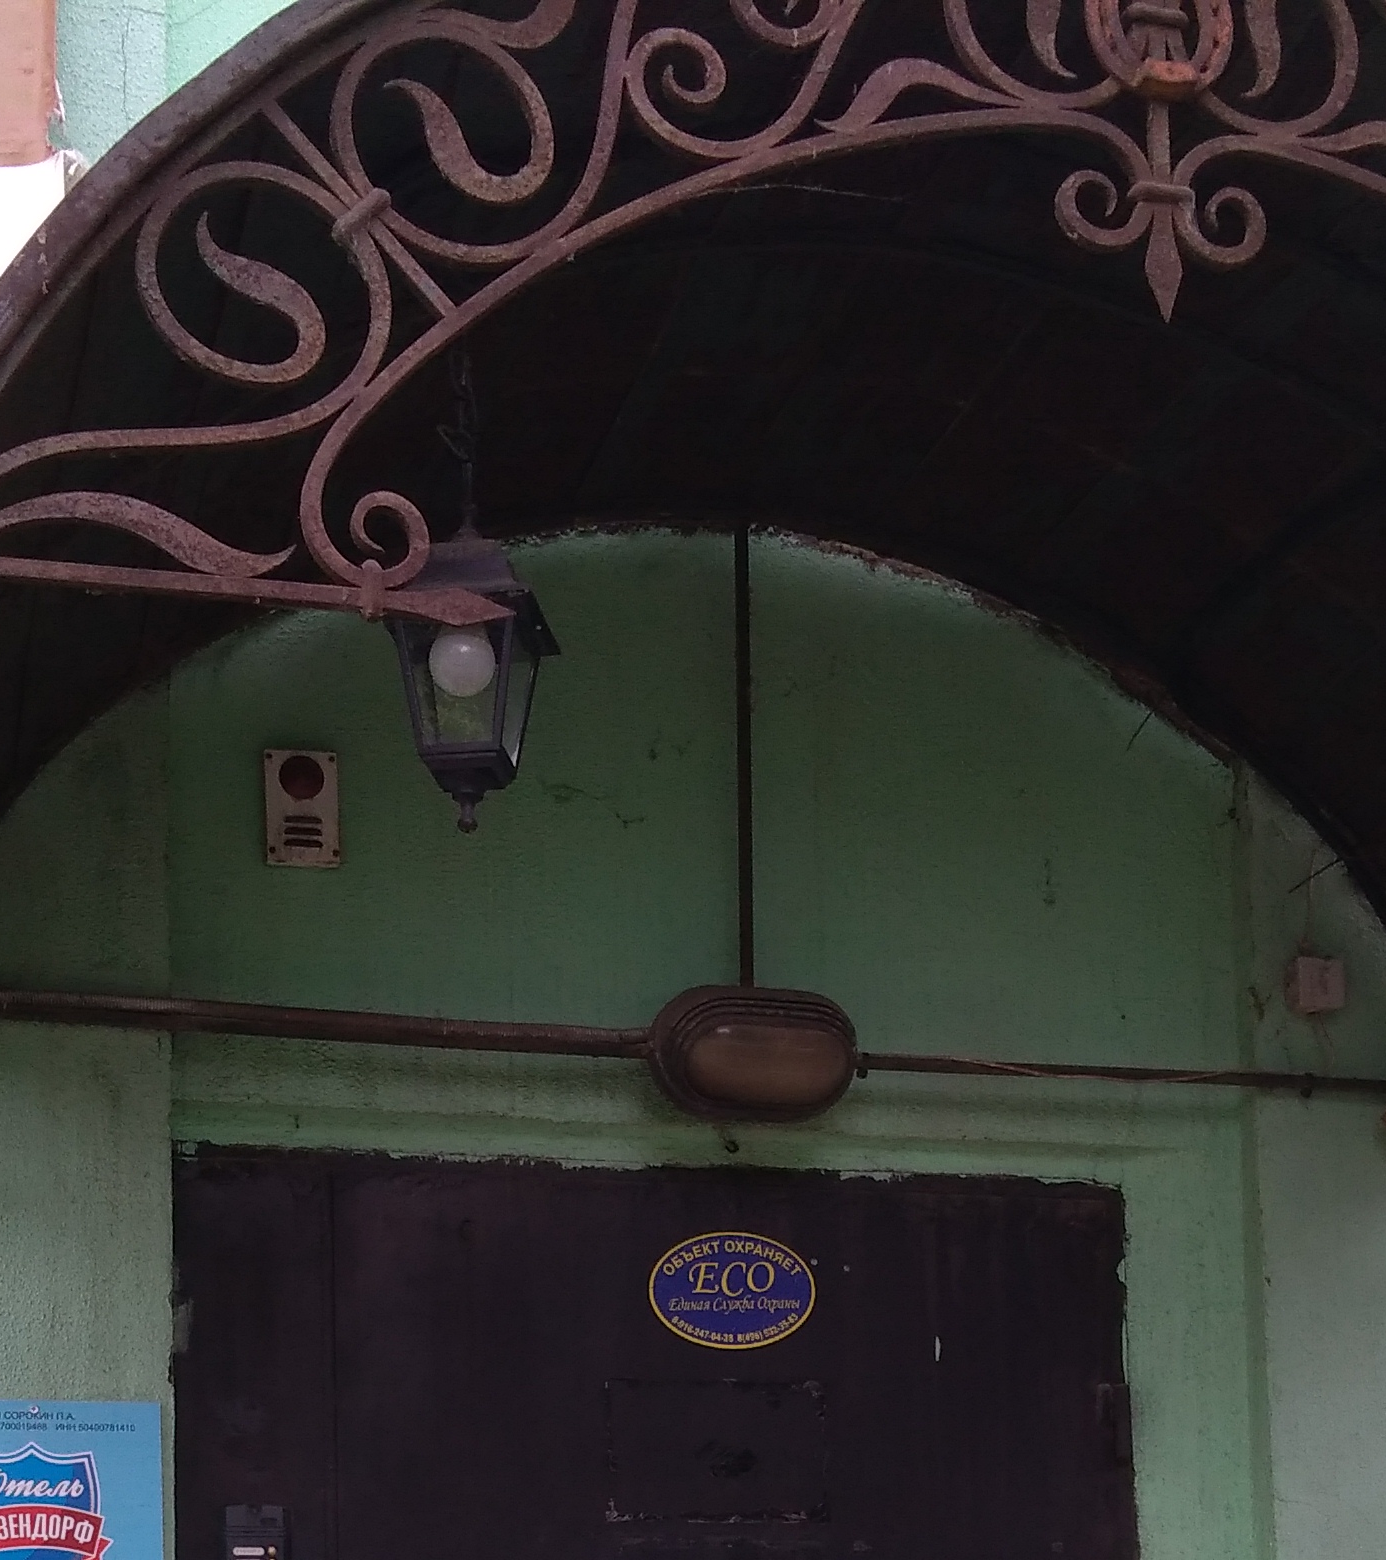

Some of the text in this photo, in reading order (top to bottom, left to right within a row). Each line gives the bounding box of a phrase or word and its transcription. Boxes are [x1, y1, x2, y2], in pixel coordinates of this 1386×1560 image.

[663, 1240, 802, 1276] ОБЪЕКТ ОХРАНЯЕТ
[668, 1295, 801, 1315] Единая Служба Охраны
[4, 1411, 54, 1421] СОРОКИН
